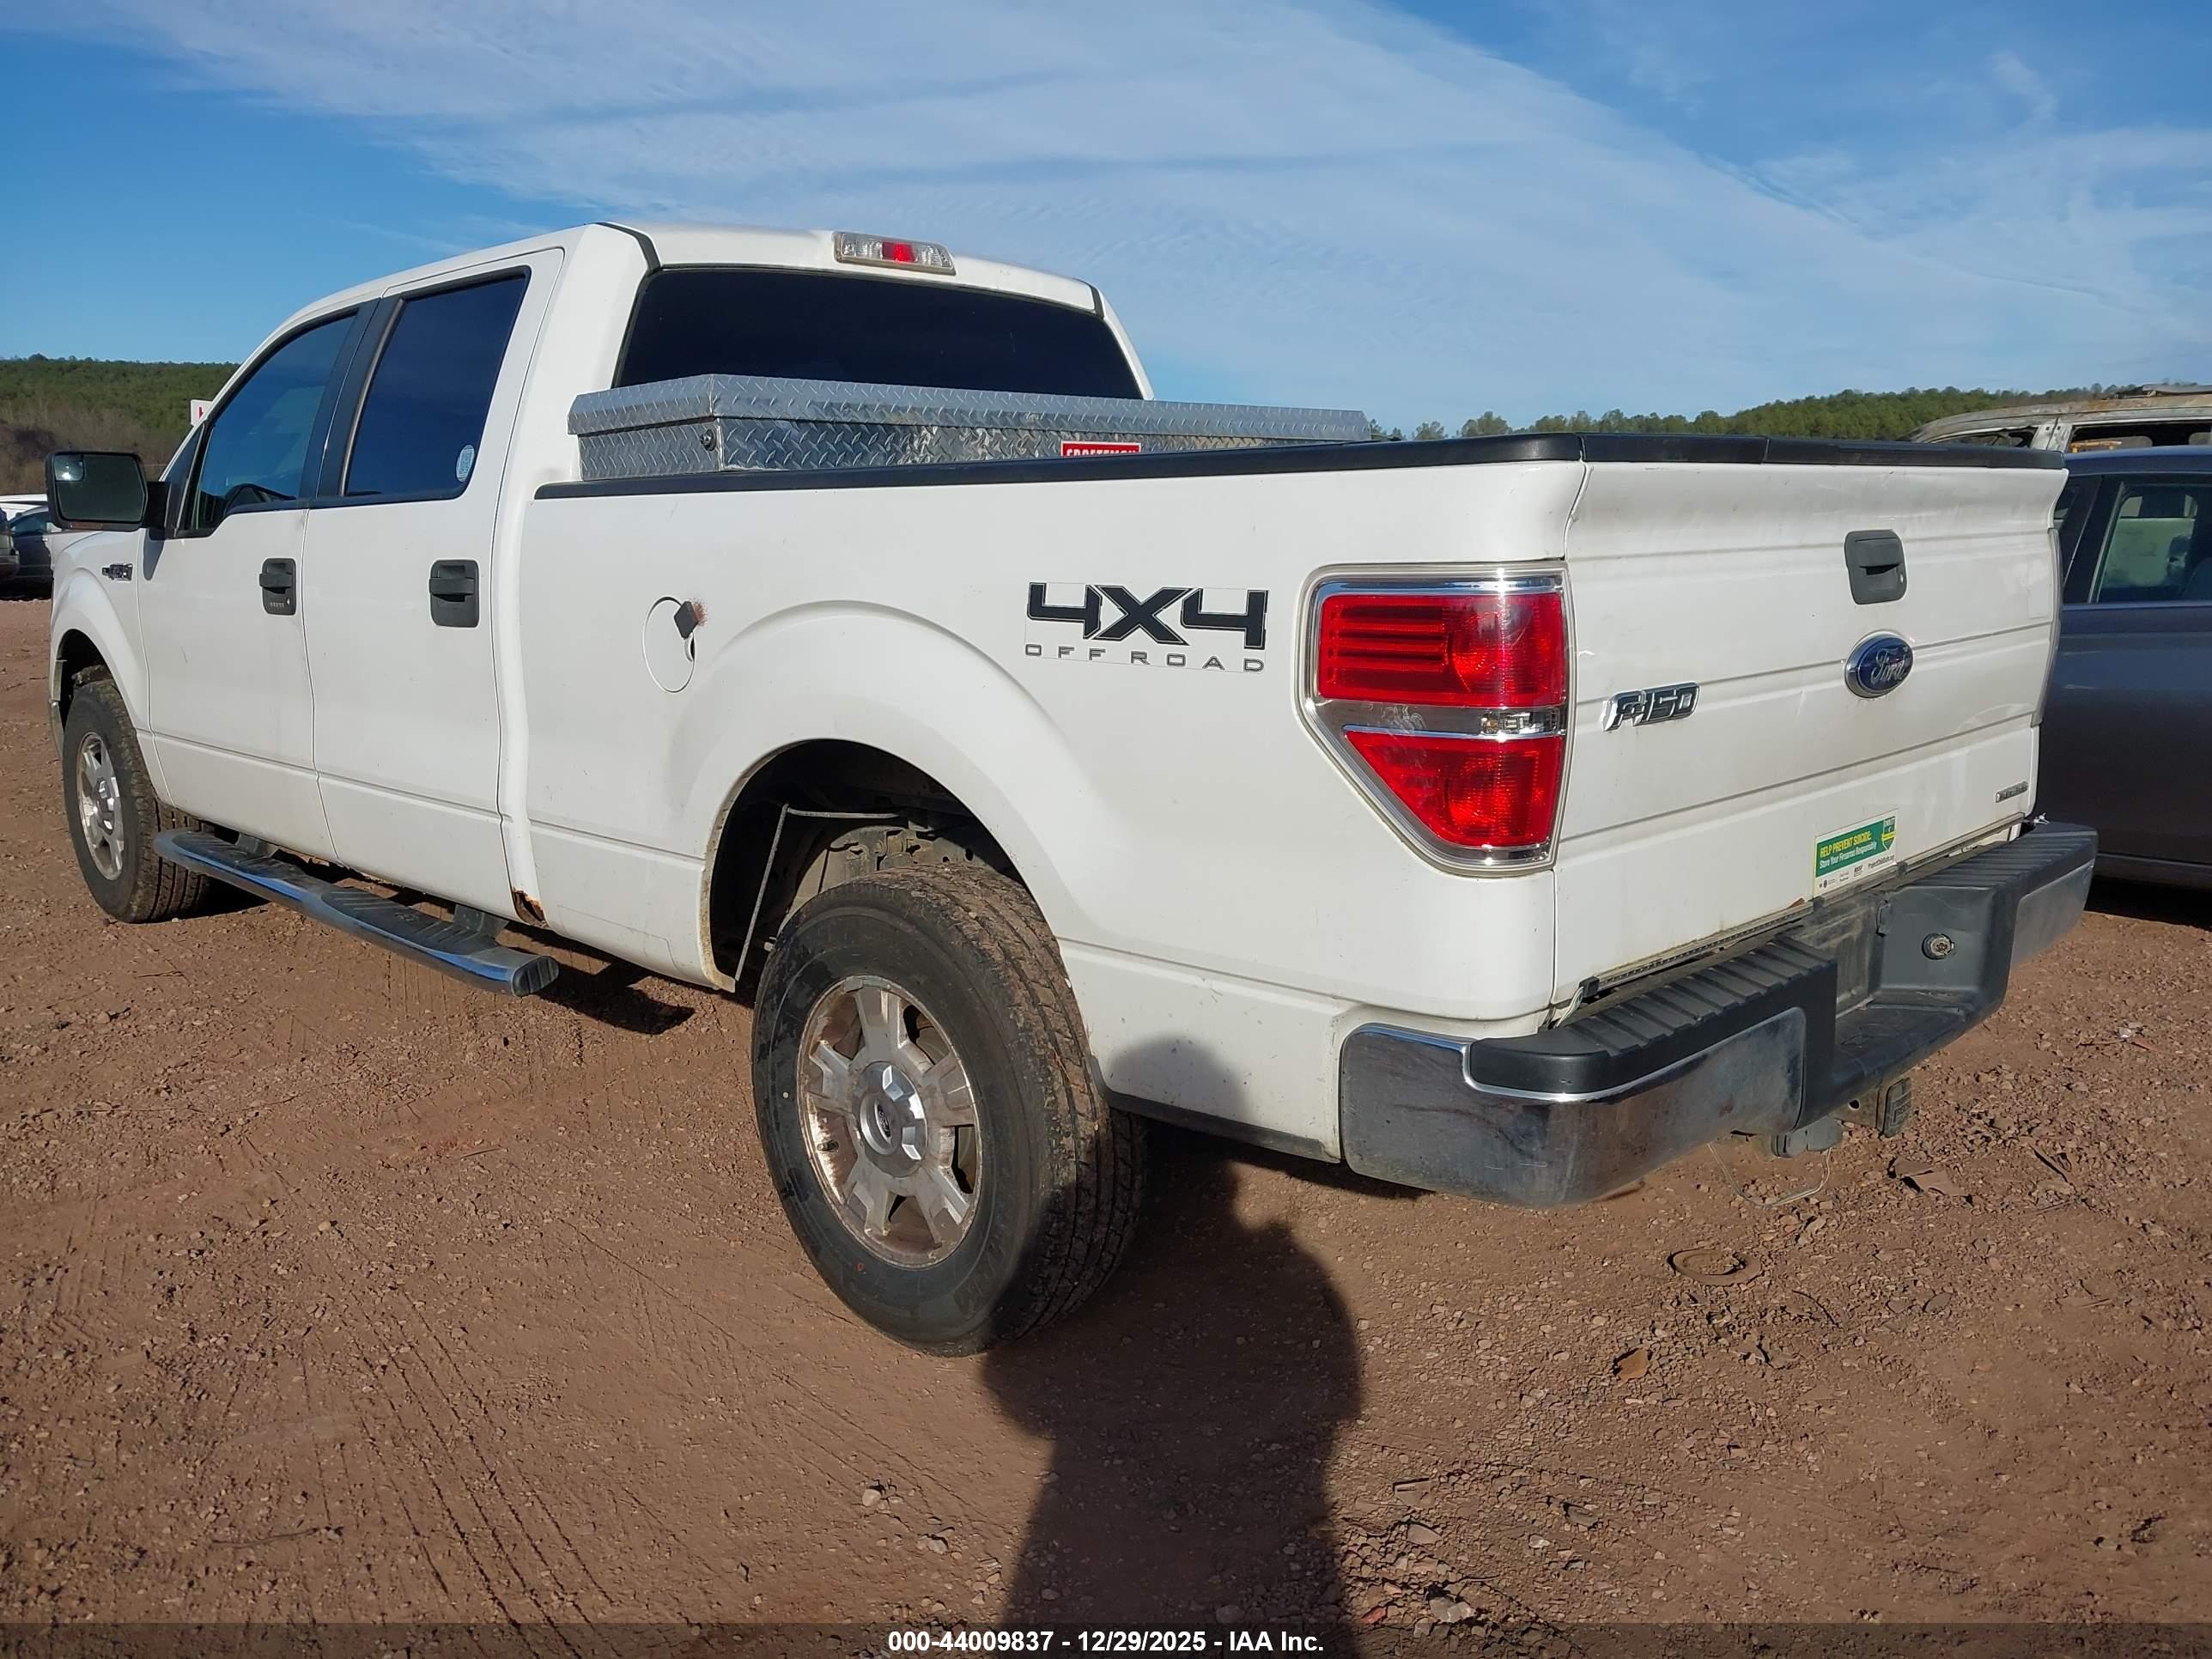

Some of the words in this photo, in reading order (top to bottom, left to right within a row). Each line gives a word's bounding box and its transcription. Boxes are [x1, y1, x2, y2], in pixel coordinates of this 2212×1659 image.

[1024, 644, 1109, 661] OFF
[1130, 650, 1265, 673] ROAD
[1601, 680, 1700, 732] F-150
[1820, 844, 1832, 859] HELP
[1832, 836, 1853, 854] PREVENT
[1819, 859, 1831, 869] Store
